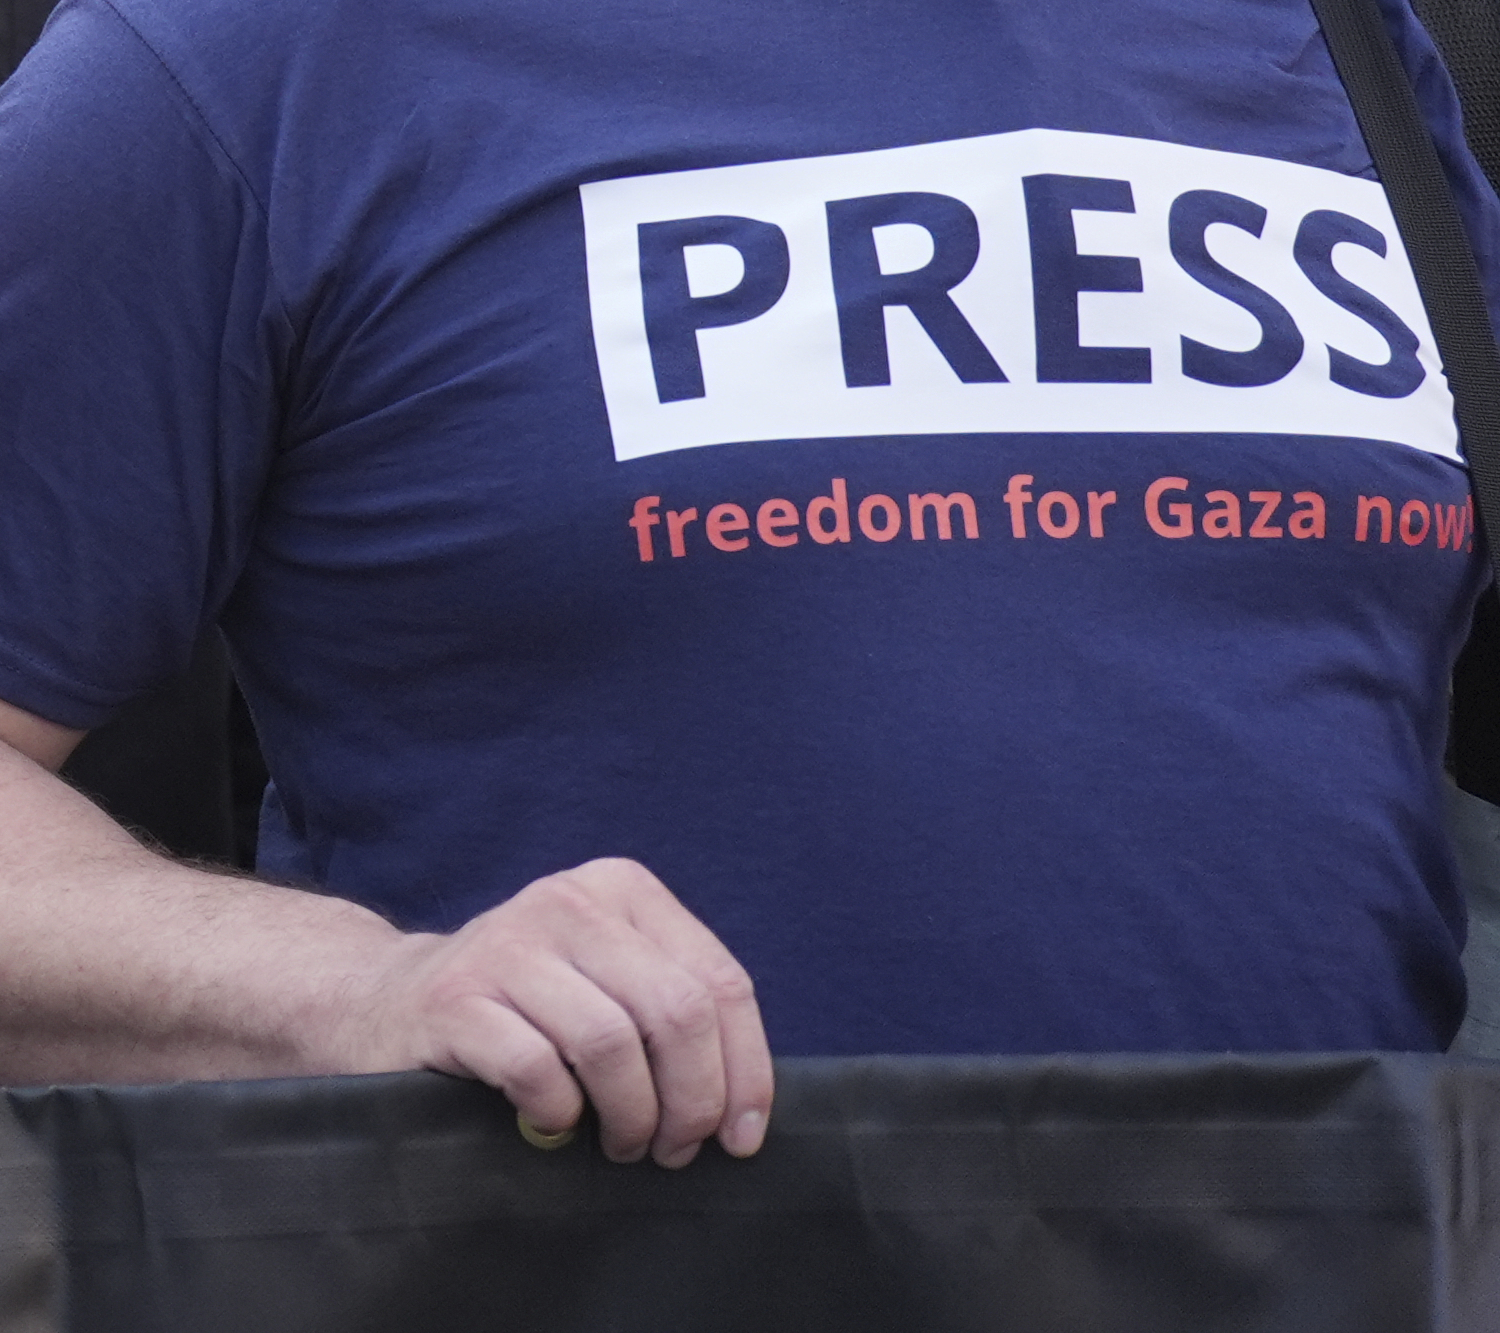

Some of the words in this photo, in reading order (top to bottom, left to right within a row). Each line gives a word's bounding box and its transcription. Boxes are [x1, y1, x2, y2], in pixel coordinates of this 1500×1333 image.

[636, 173, 1428, 405] PRESS
[628, 478, 980, 563] freedom
[1003, 474, 1117, 541] for
[1143, 476, 1327, 540] Gaza
[1354, 493, 1475, 554] now!
